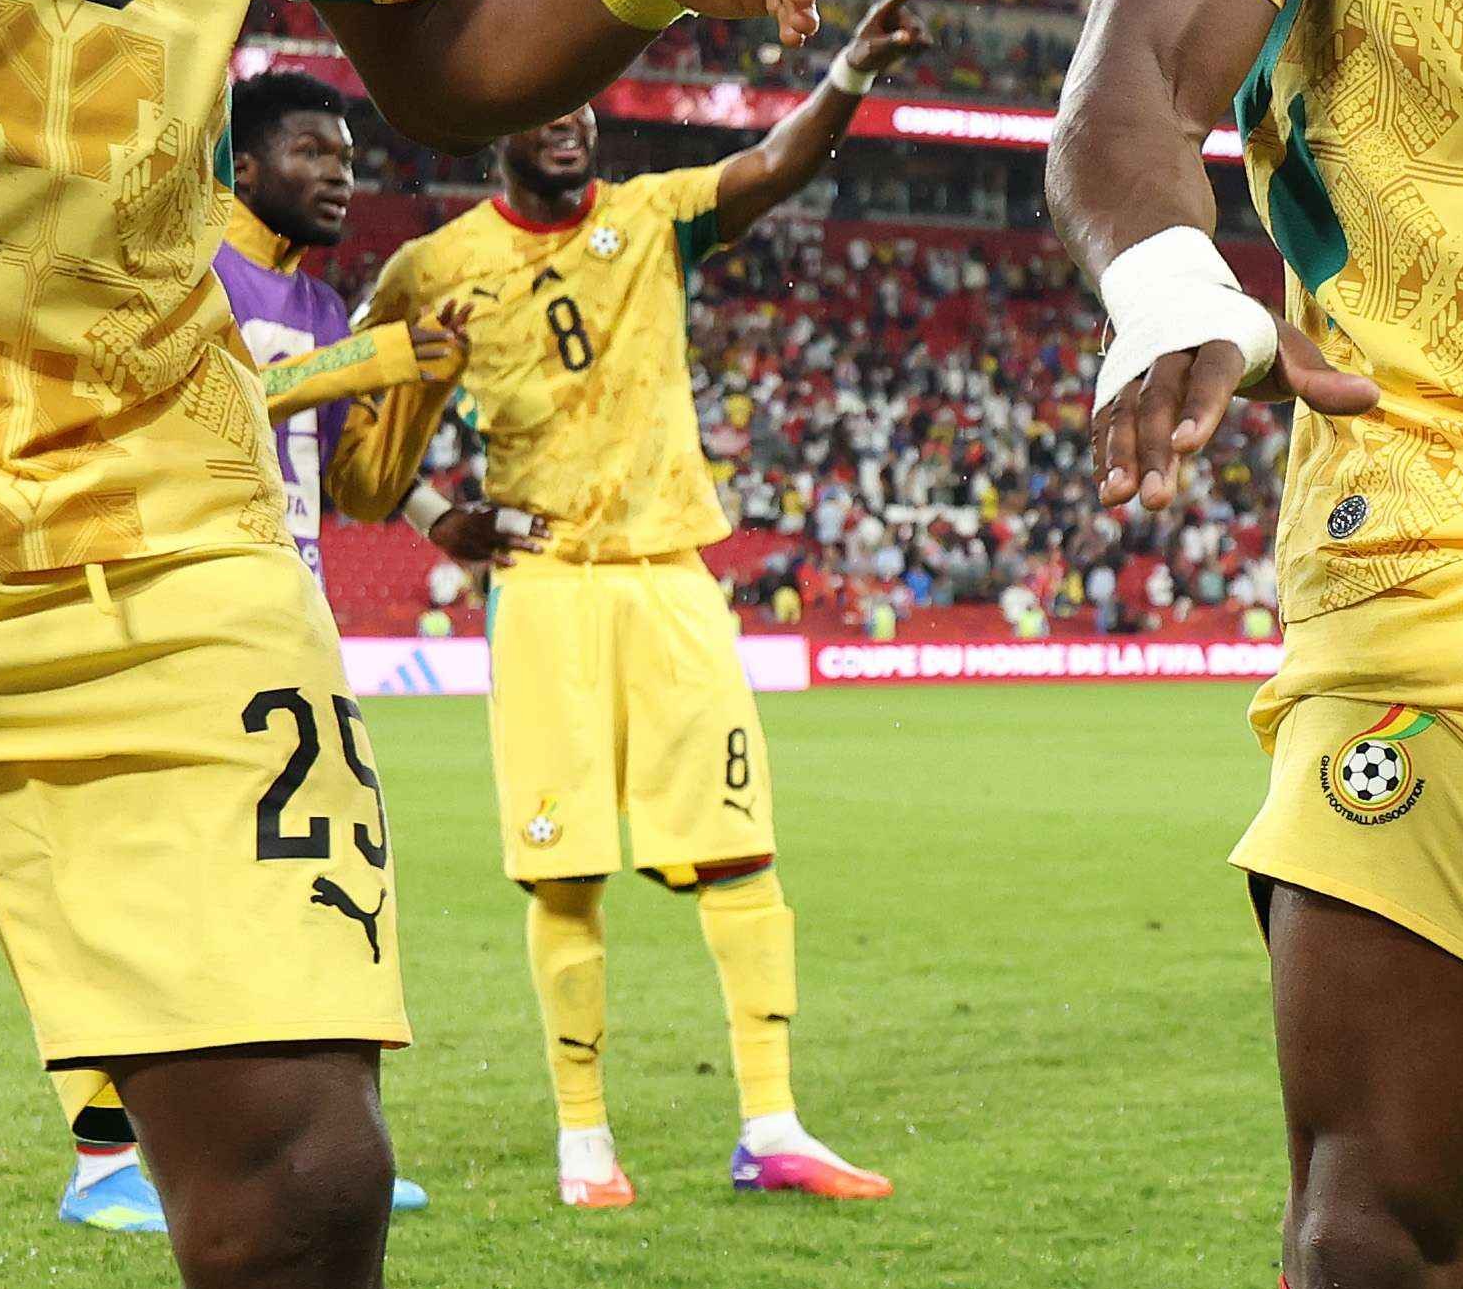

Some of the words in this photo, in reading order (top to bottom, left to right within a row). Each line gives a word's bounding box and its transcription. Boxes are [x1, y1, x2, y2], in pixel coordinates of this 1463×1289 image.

[547, 294, 593, 372] 8
[818, 644, 918, 678] COUPE
[241, 687, 387, 870] 25
[727, 727, 749, 789] 8
[1320, 755, 1330, 793] GHANA
[1325, 793, 1373, 825] FOOTBALL
[1372, 778, 1426, 825] ASSOCIATION
